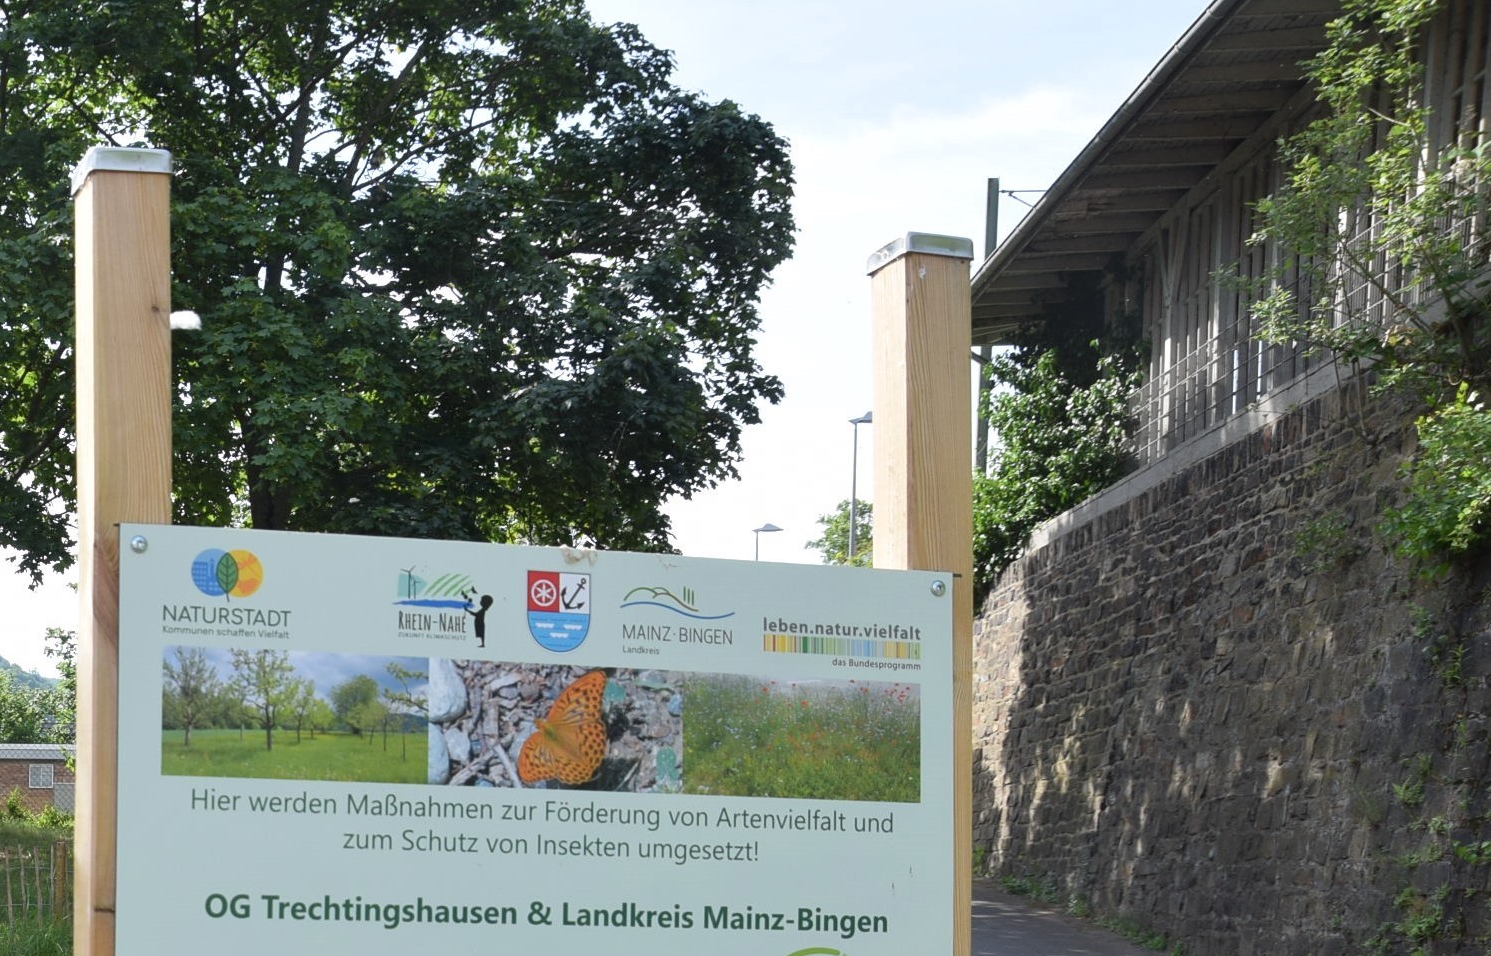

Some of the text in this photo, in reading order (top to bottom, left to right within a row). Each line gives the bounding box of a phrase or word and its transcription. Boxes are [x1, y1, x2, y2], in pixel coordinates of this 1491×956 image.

[162, 605, 292, 627] NATURSTADT
[162, 625, 290, 640] Kommunen schaffen Vielfalt
[763, 617, 922, 641] leben.natur.vielfalt
[621, 644, 660, 655] Landkreis
[831, 657, 922, 671] das Bundesprogramm
[191, 787, 894, 834] Hier werden Maßnahmen zur Förderung von Artenvielfalt und
[342, 829, 760, 866] zum Schutz von Insekten umgesetzt!
[204, 893, 889, 939] OG Trechtingshausen & Landkreis Mainz-Bingen
